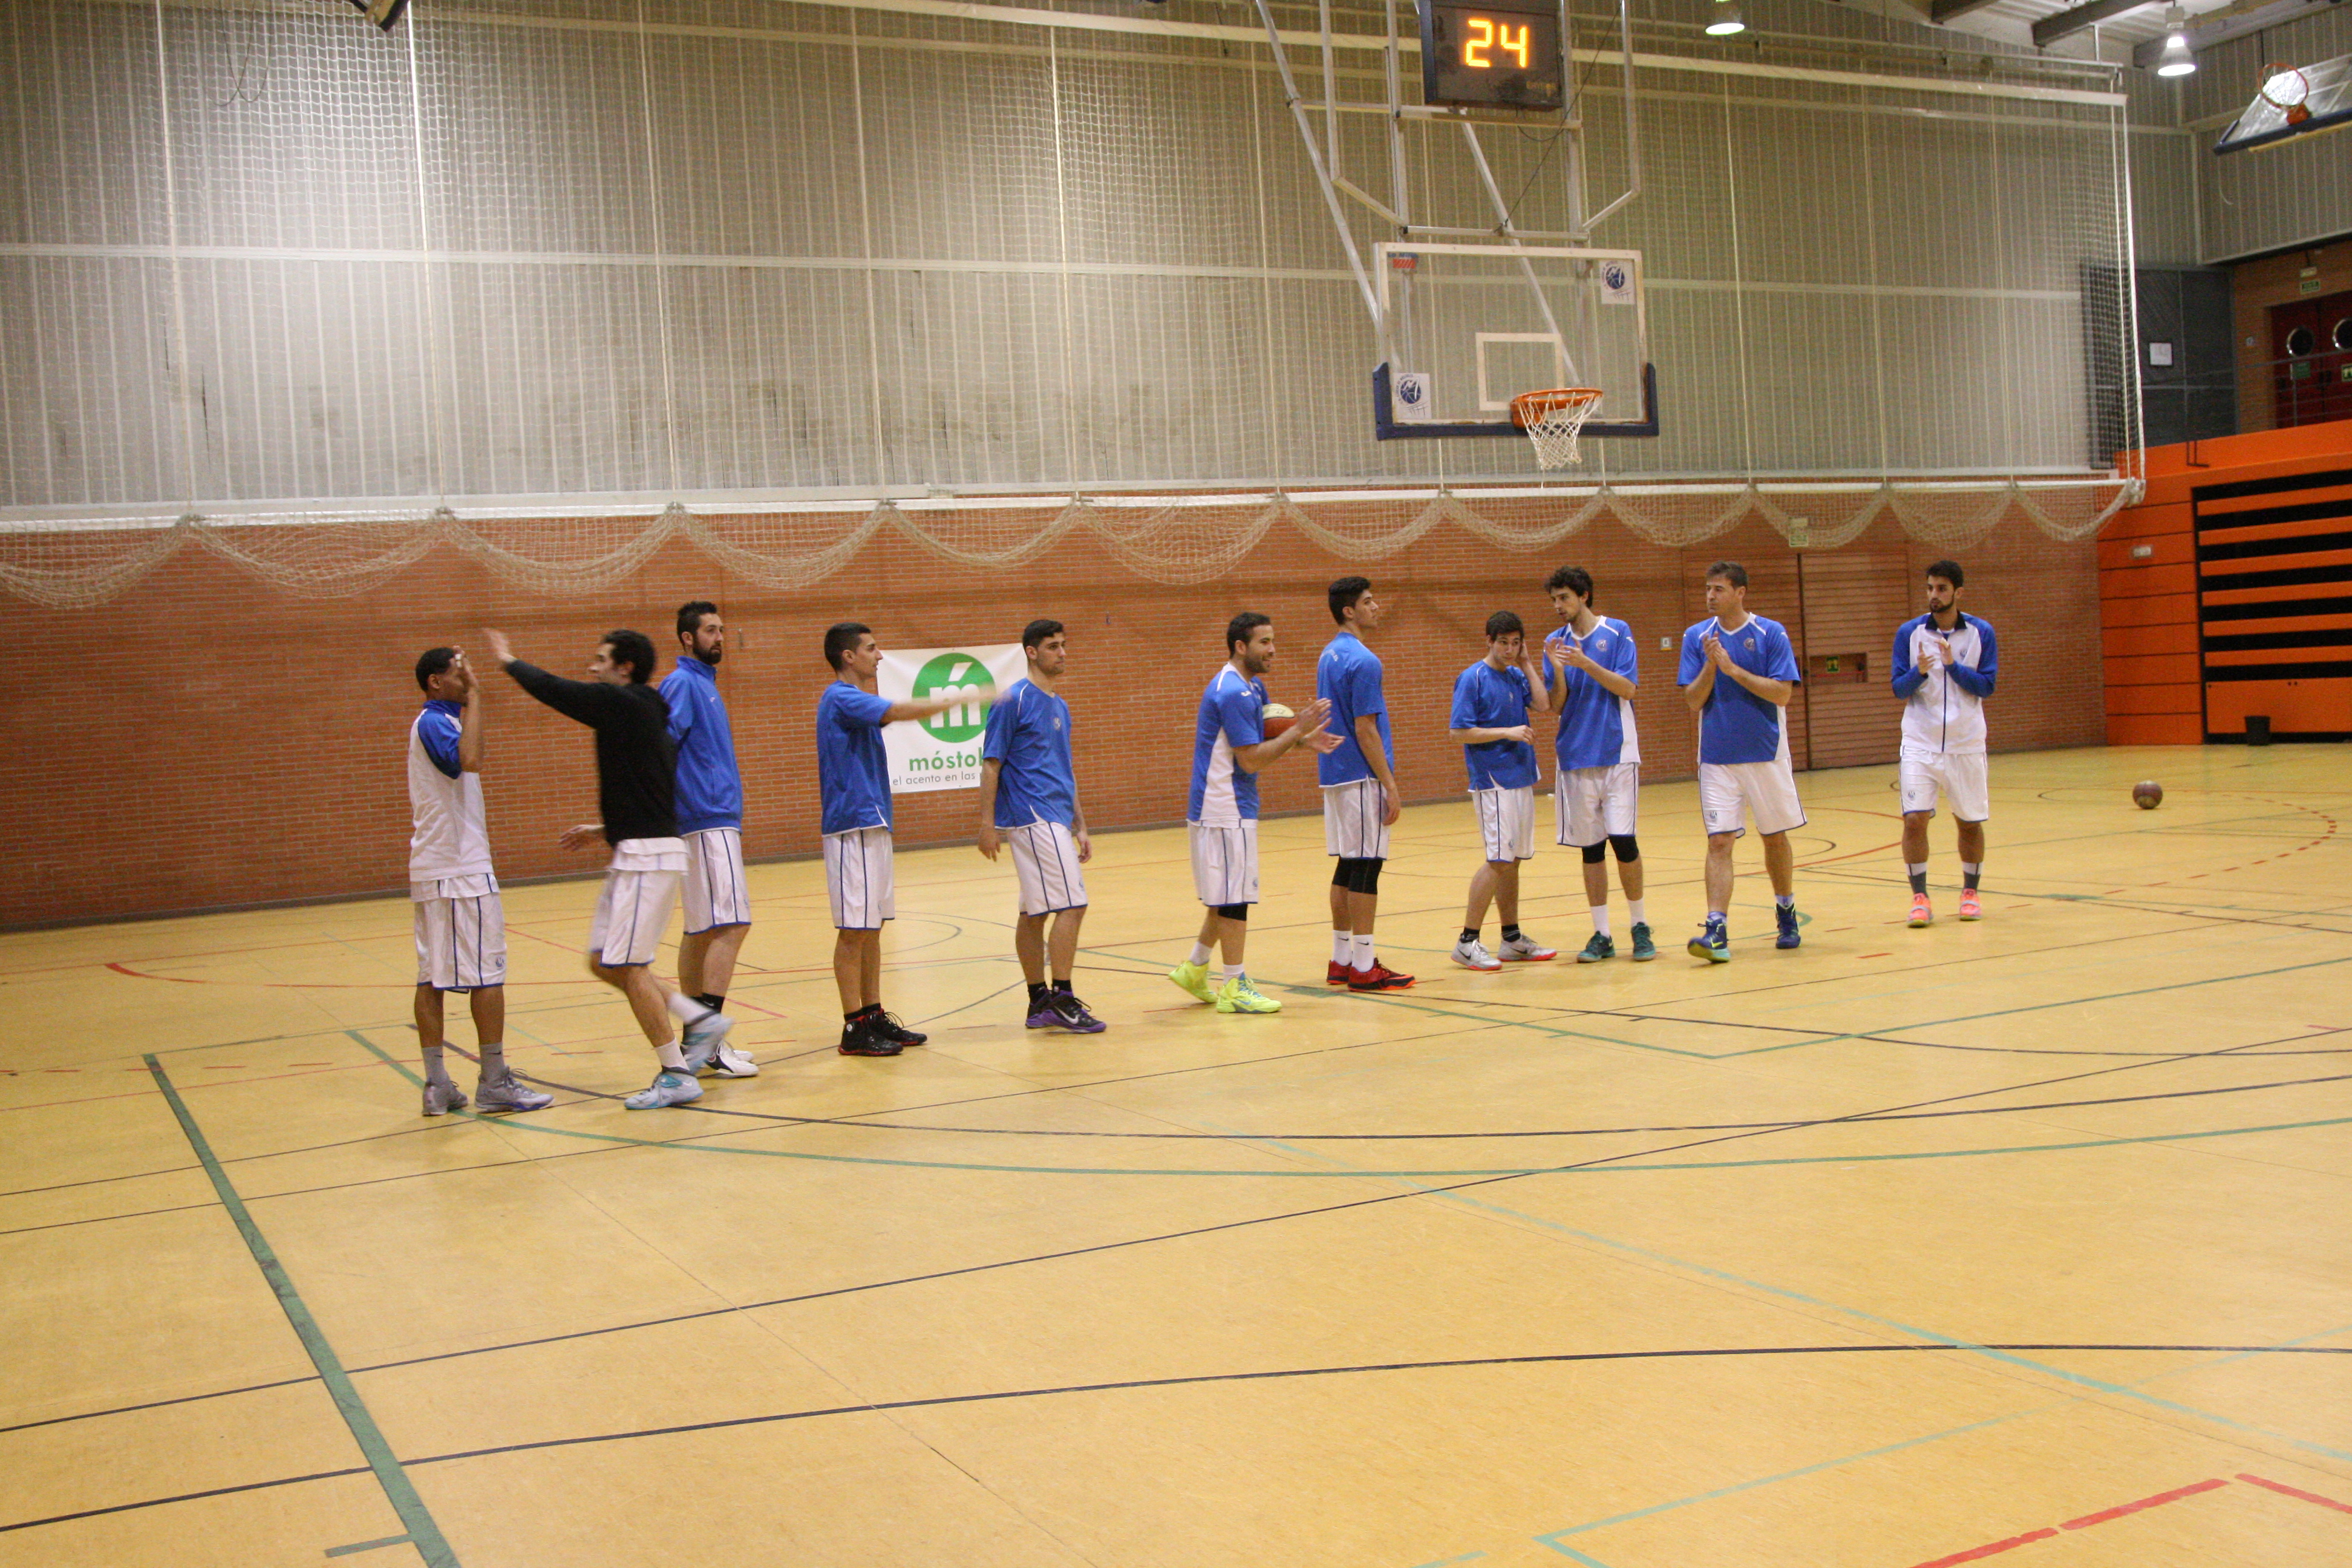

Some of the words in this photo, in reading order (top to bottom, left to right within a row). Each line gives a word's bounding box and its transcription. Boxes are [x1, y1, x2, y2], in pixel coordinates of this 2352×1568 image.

[1465, 19, 1528, 68] 24
[909, 746, 983, 771] móstol
[892, 776, 902, 785] el
[906, 774, 941, 785] acento
[945, 773, 957, 782] en
[961, 771, 976, 780] las
